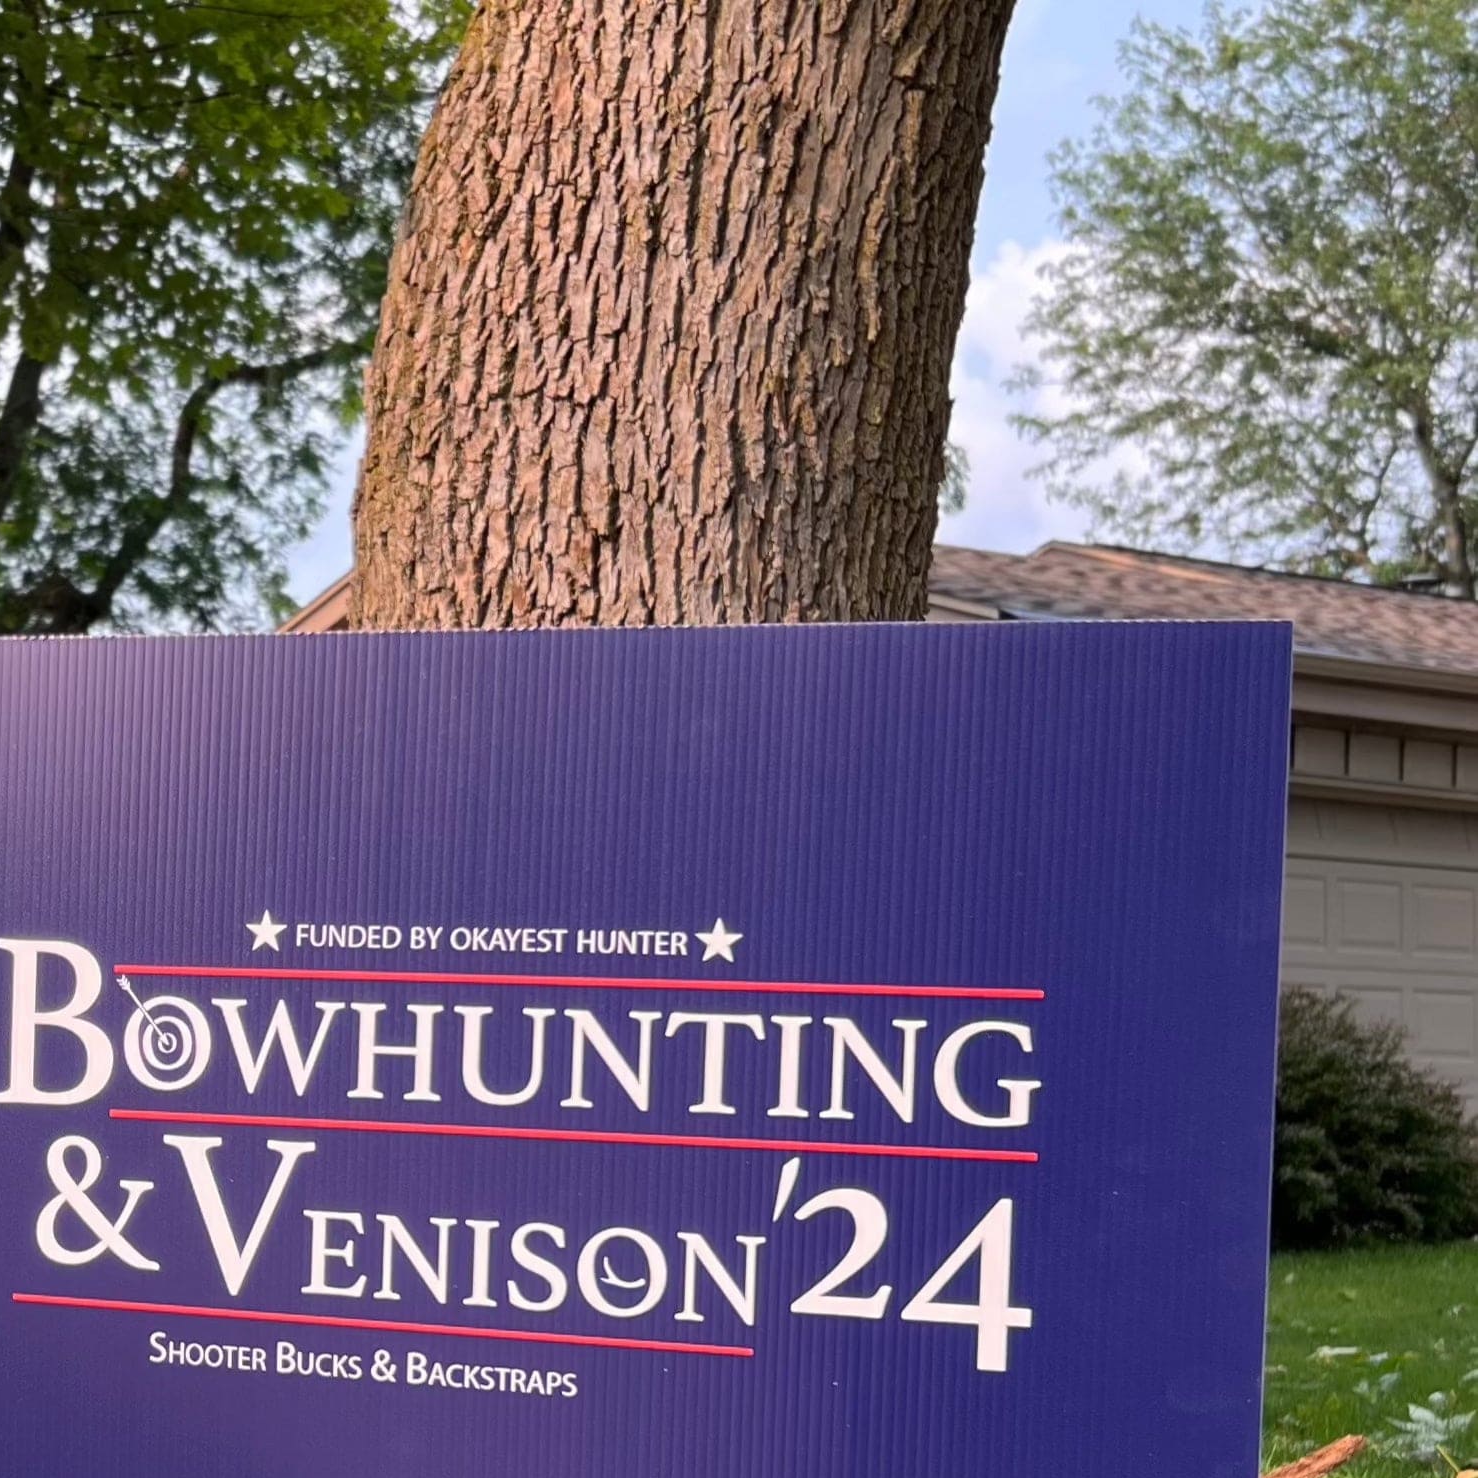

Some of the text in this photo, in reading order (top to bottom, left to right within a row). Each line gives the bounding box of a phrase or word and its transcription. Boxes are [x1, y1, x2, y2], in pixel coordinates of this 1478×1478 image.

[295, 923, 688, 956] FUNDED BY OKAYEST HUNTER
[35, 1134, 161, 1272] &
[162, 1133, 767, 1327] VENISON
[149, 1331, 578, 1398] SHOOTER BUCKS & BACKSTRAPS
